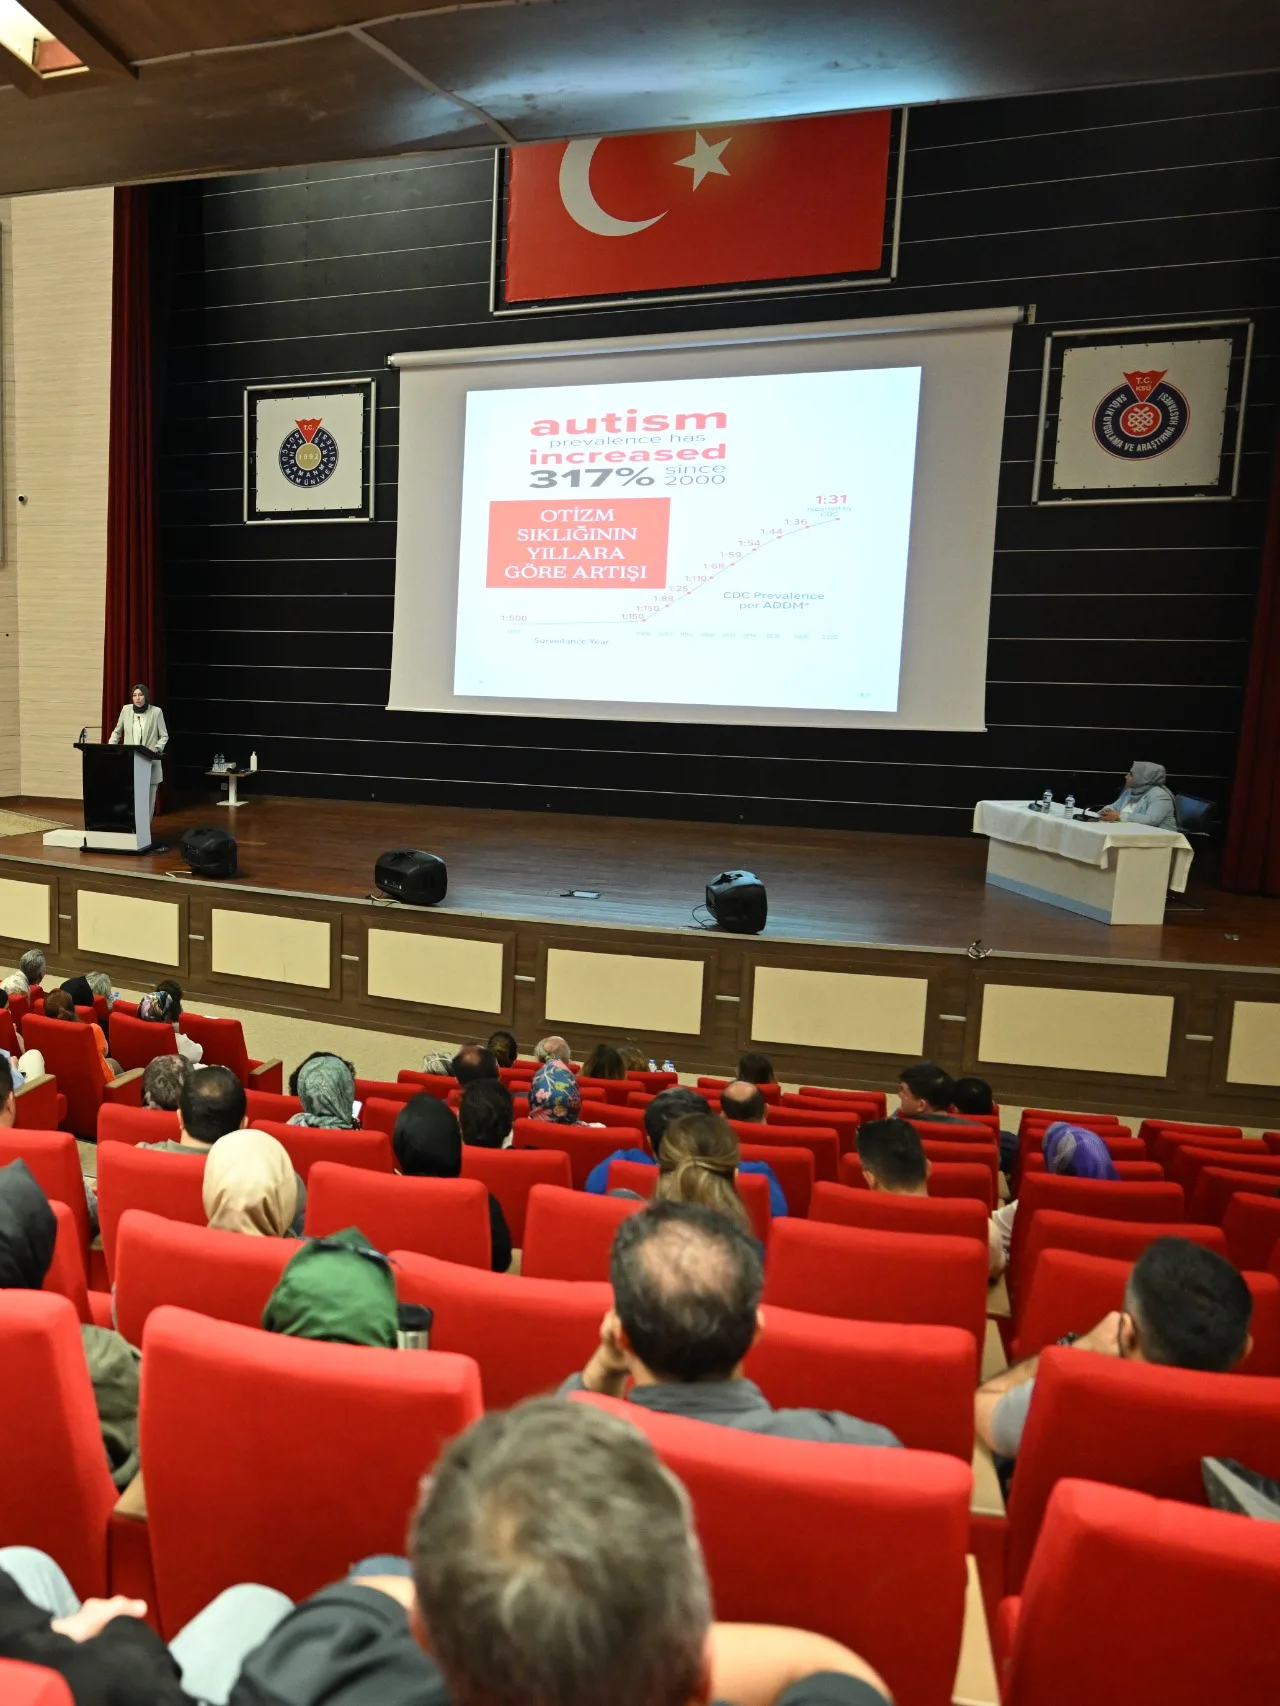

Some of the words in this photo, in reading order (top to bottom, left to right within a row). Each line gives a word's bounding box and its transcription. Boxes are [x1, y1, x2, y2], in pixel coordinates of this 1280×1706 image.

[530, 408, 727, 436] autism
[550, 434, 662, 449] prevalence
[670, 433, 706, 443] has
[1124, 442, 1135, 452] VE
[1136, 426, 1176, 452] ARAŞTIRMA
[529, 443, 727, 465] increased
[665, 464, 726, 475] since
[529, 467, 655, 489] 317%
[665, 475, 726, 486] 2000
[816, 495, 848, 505] 1:31
[540, 506, 615, 523] OTİZM
[517, 525, 637, 541] SIKLIĞININ
[527, 547, 625, 560] YILLARA
[504, 564, 567, 579] GÖRE
[572, 565, 647, 582] ARTIŞI
[723, 591, 750, 600] CDC
[754, 591, 825, 600] Prevalence
[739, 603, 760, 611] per
